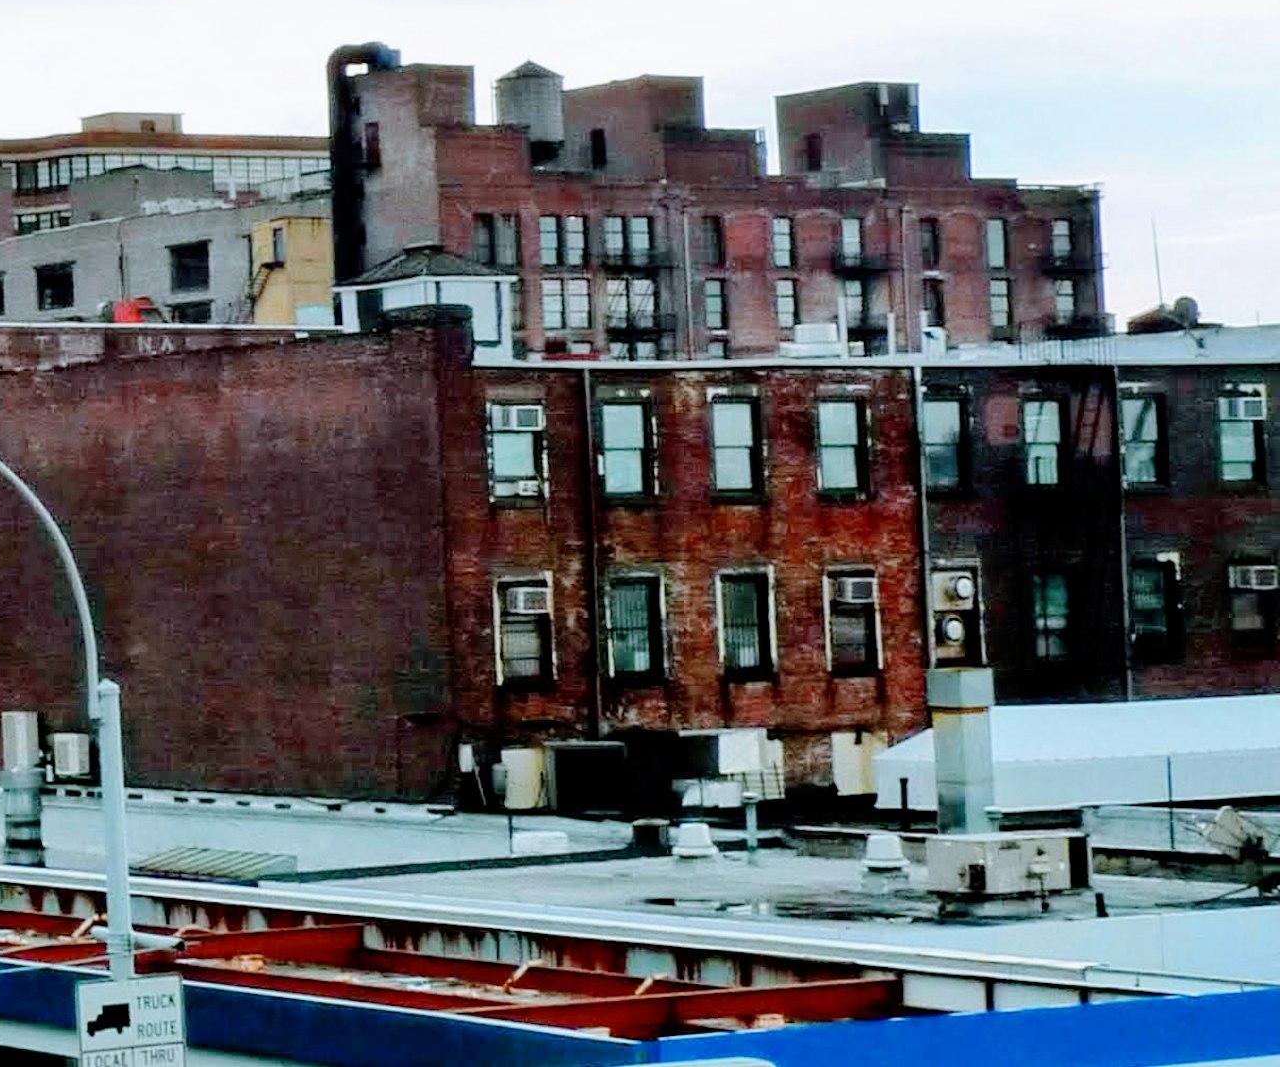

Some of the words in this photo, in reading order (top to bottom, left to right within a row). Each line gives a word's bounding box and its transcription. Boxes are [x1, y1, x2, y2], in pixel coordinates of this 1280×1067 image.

[137, 994, 175, 1009] TRUCK
[137, 1020, 176, 1038] ROUTE
[143, 1048, 175, 1064] THRU
